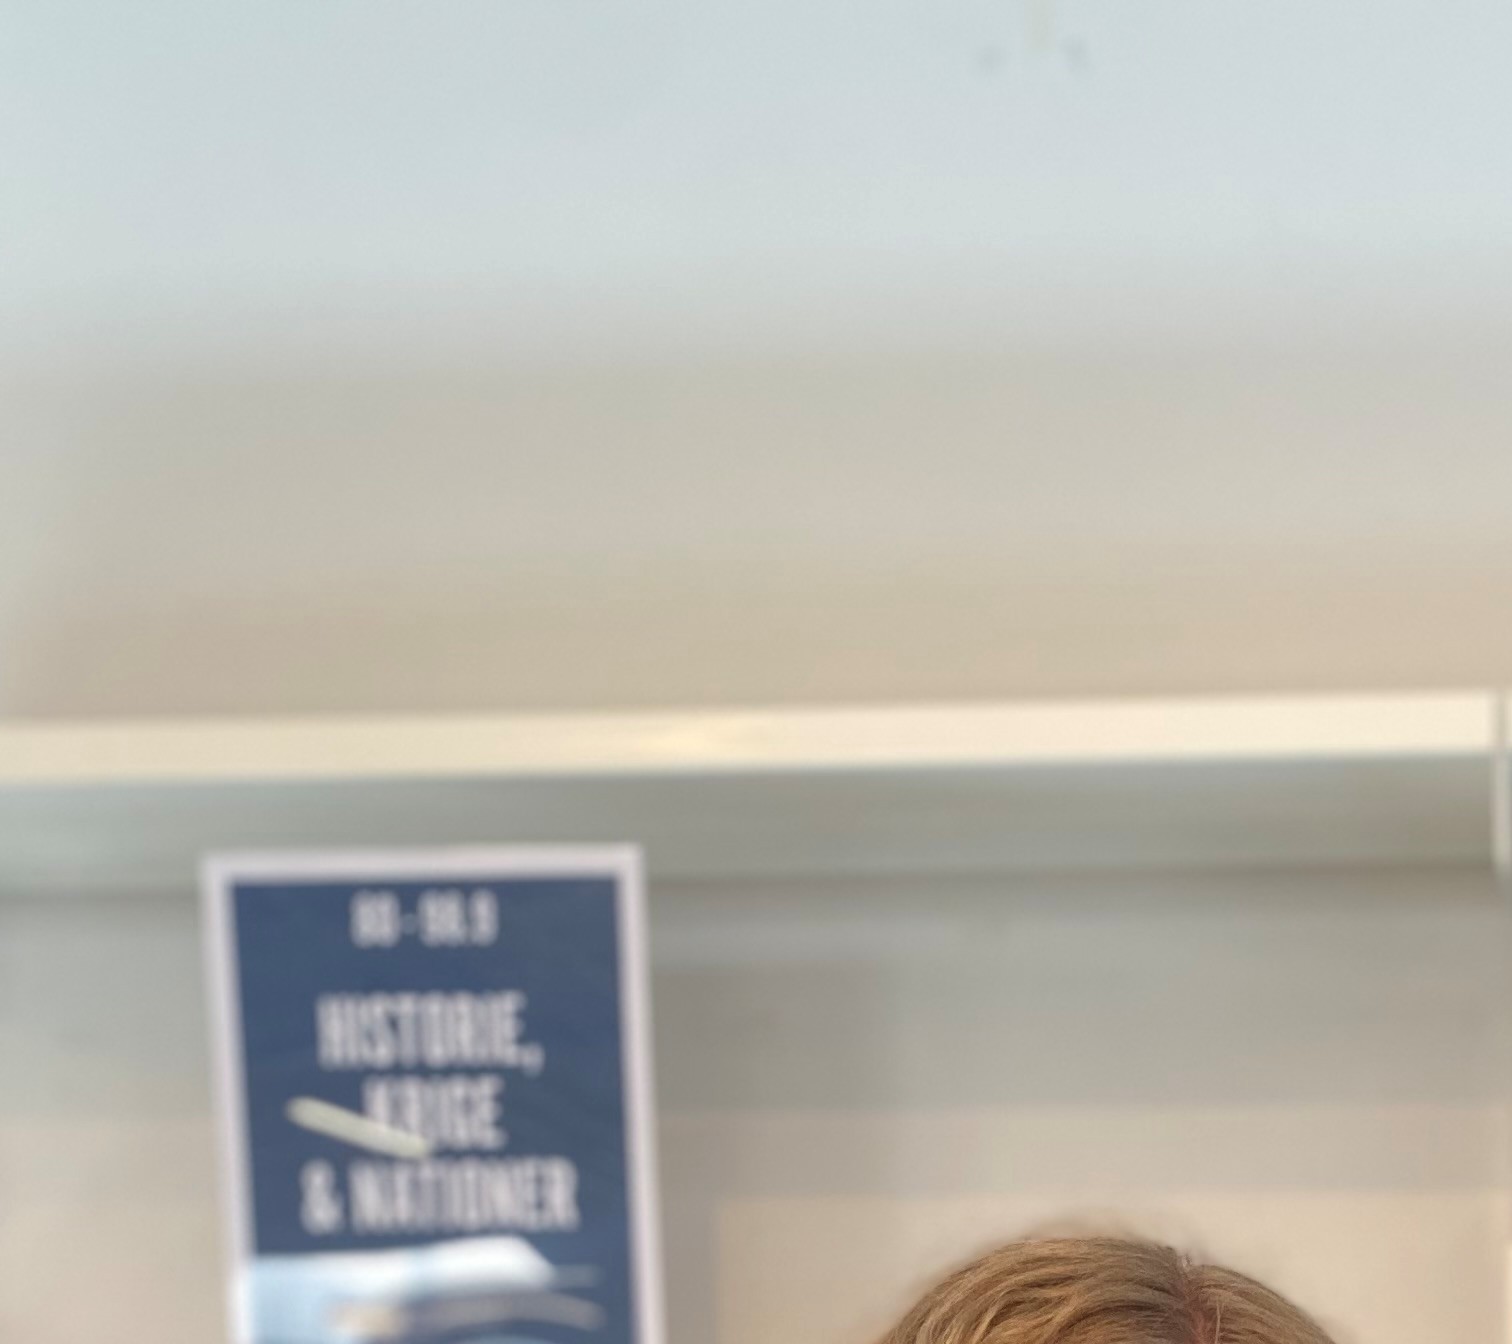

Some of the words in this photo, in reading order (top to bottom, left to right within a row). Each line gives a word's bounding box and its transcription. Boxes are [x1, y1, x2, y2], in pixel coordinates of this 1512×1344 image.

[317, 991, 544, 1076] HISTORIE,
[302, 1160, 342, 1234] &
[349, 1157, 581, 1234] NATIONER
